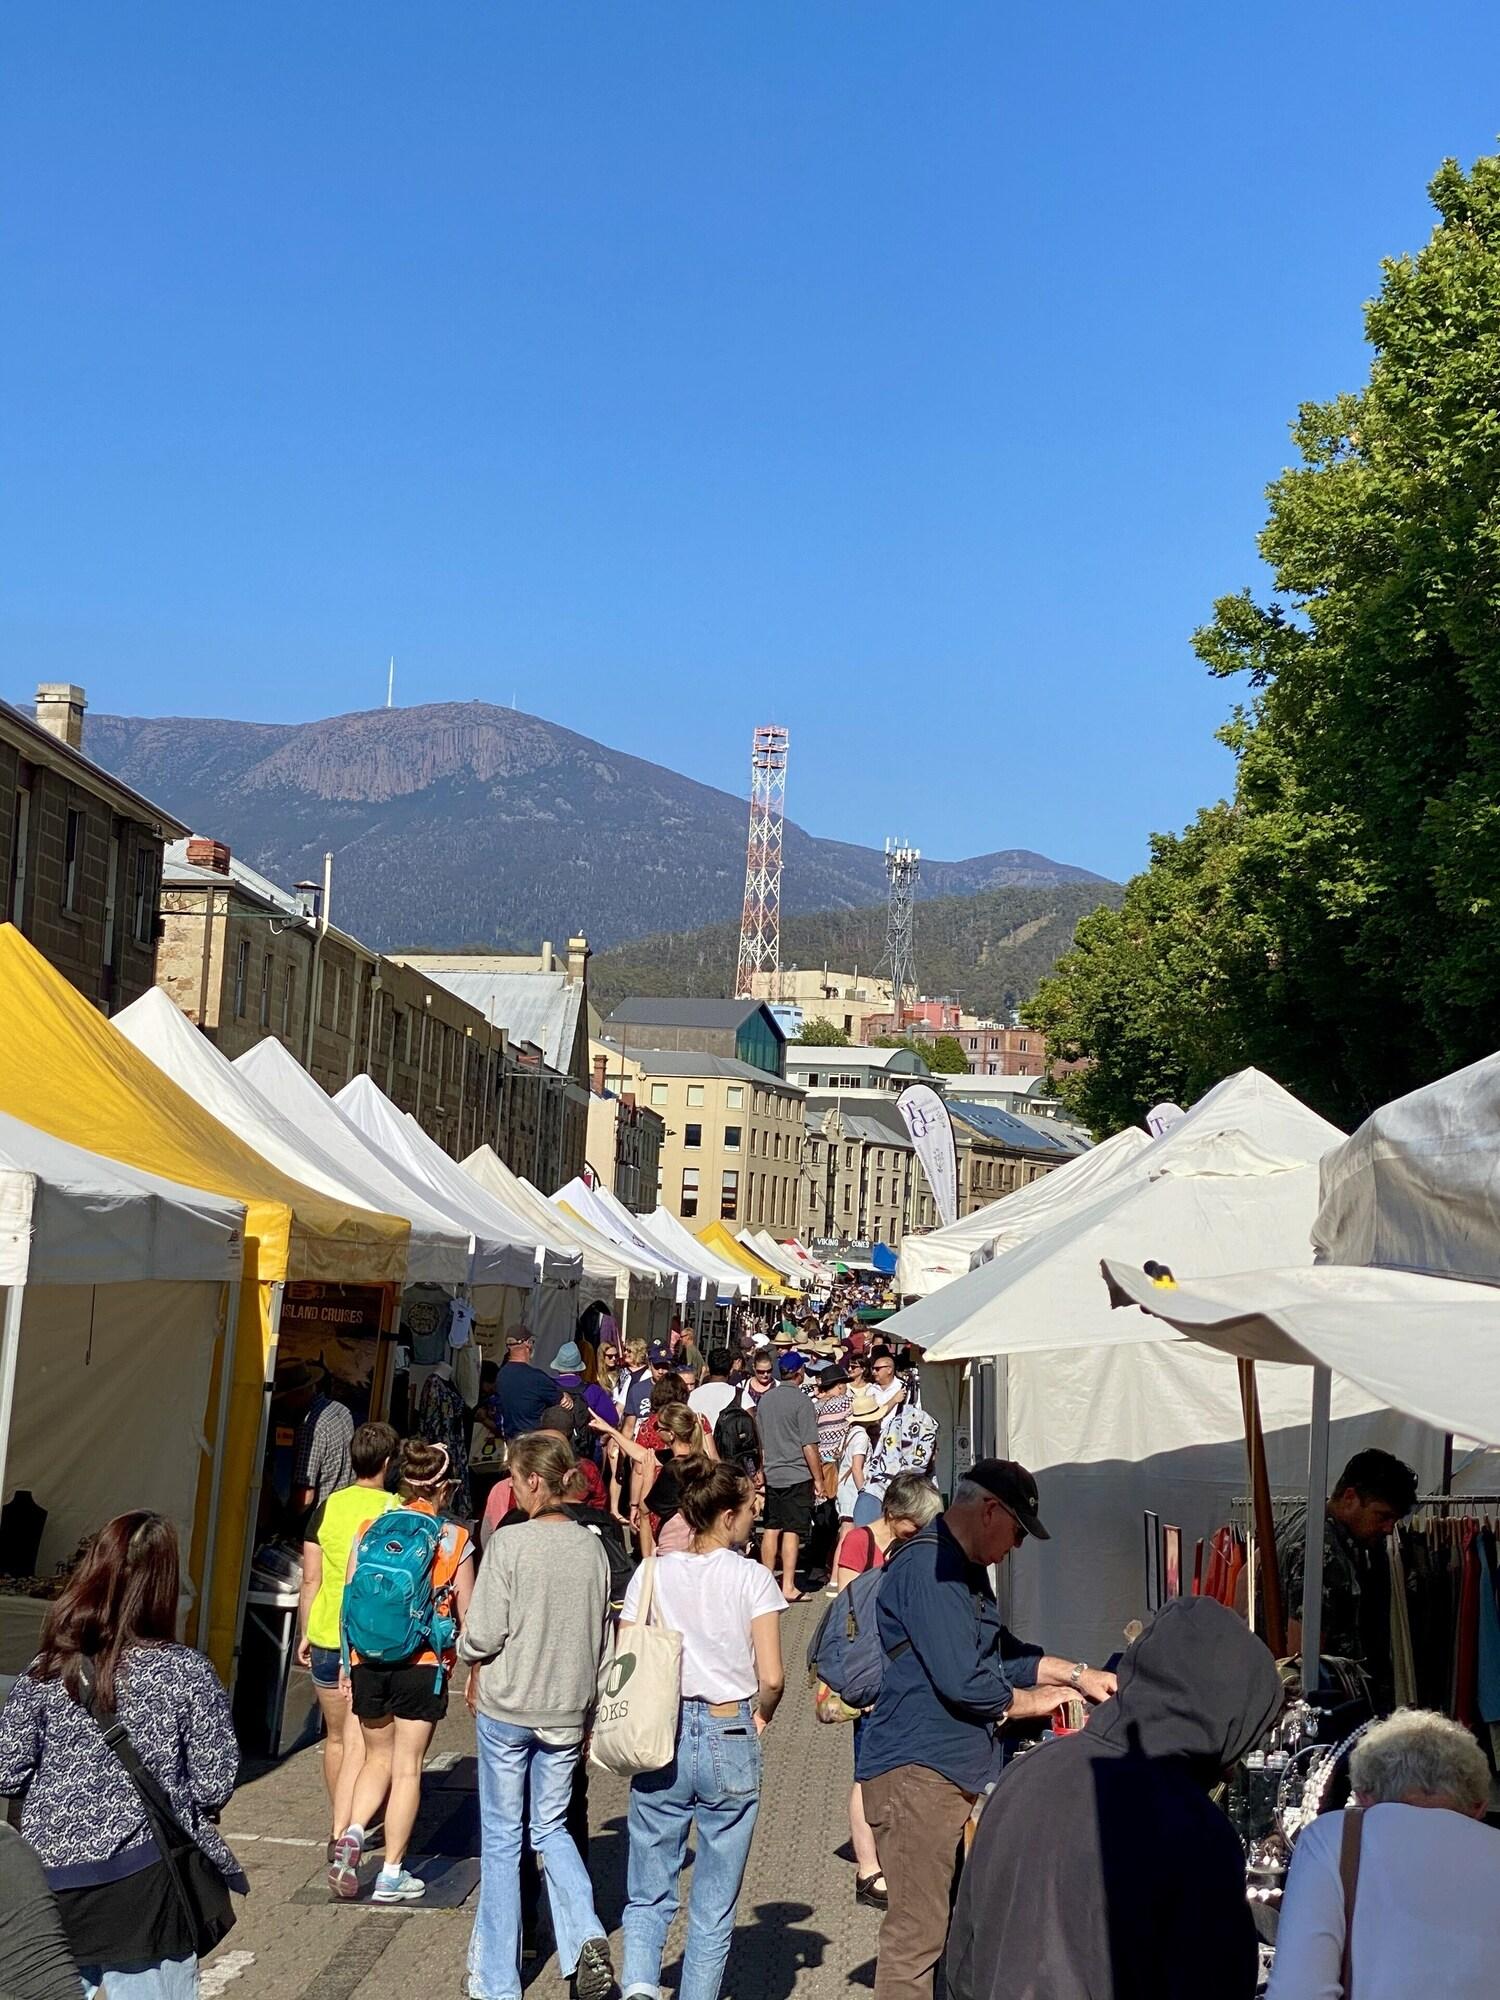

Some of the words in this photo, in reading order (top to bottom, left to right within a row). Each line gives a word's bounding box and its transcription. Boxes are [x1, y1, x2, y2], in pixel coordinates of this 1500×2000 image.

[817, 1238, 839, 1246] VIKING
[851, 1240, 870, 1249] CONES
[282, 1303, 318, 1320] ISLAND
[321, 1306, 364, 1324] CRUISES
